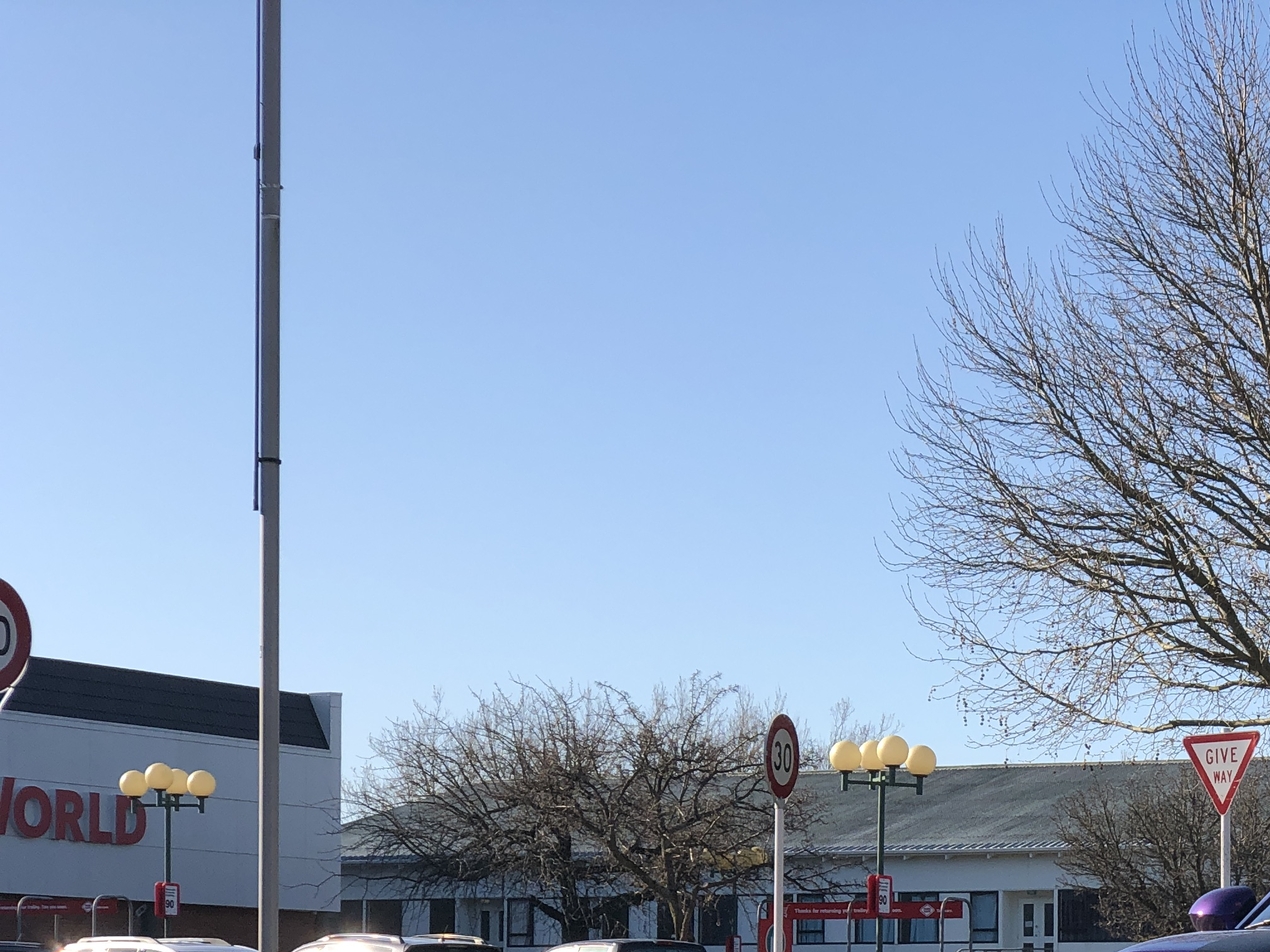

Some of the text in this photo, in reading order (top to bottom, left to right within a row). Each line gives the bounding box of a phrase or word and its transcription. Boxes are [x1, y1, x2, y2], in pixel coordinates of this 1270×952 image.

[774, 741, 792, 773] 30
[1205, 746, 1238, 765] GIVE
[1213, 770, 1233, 784] WAY
